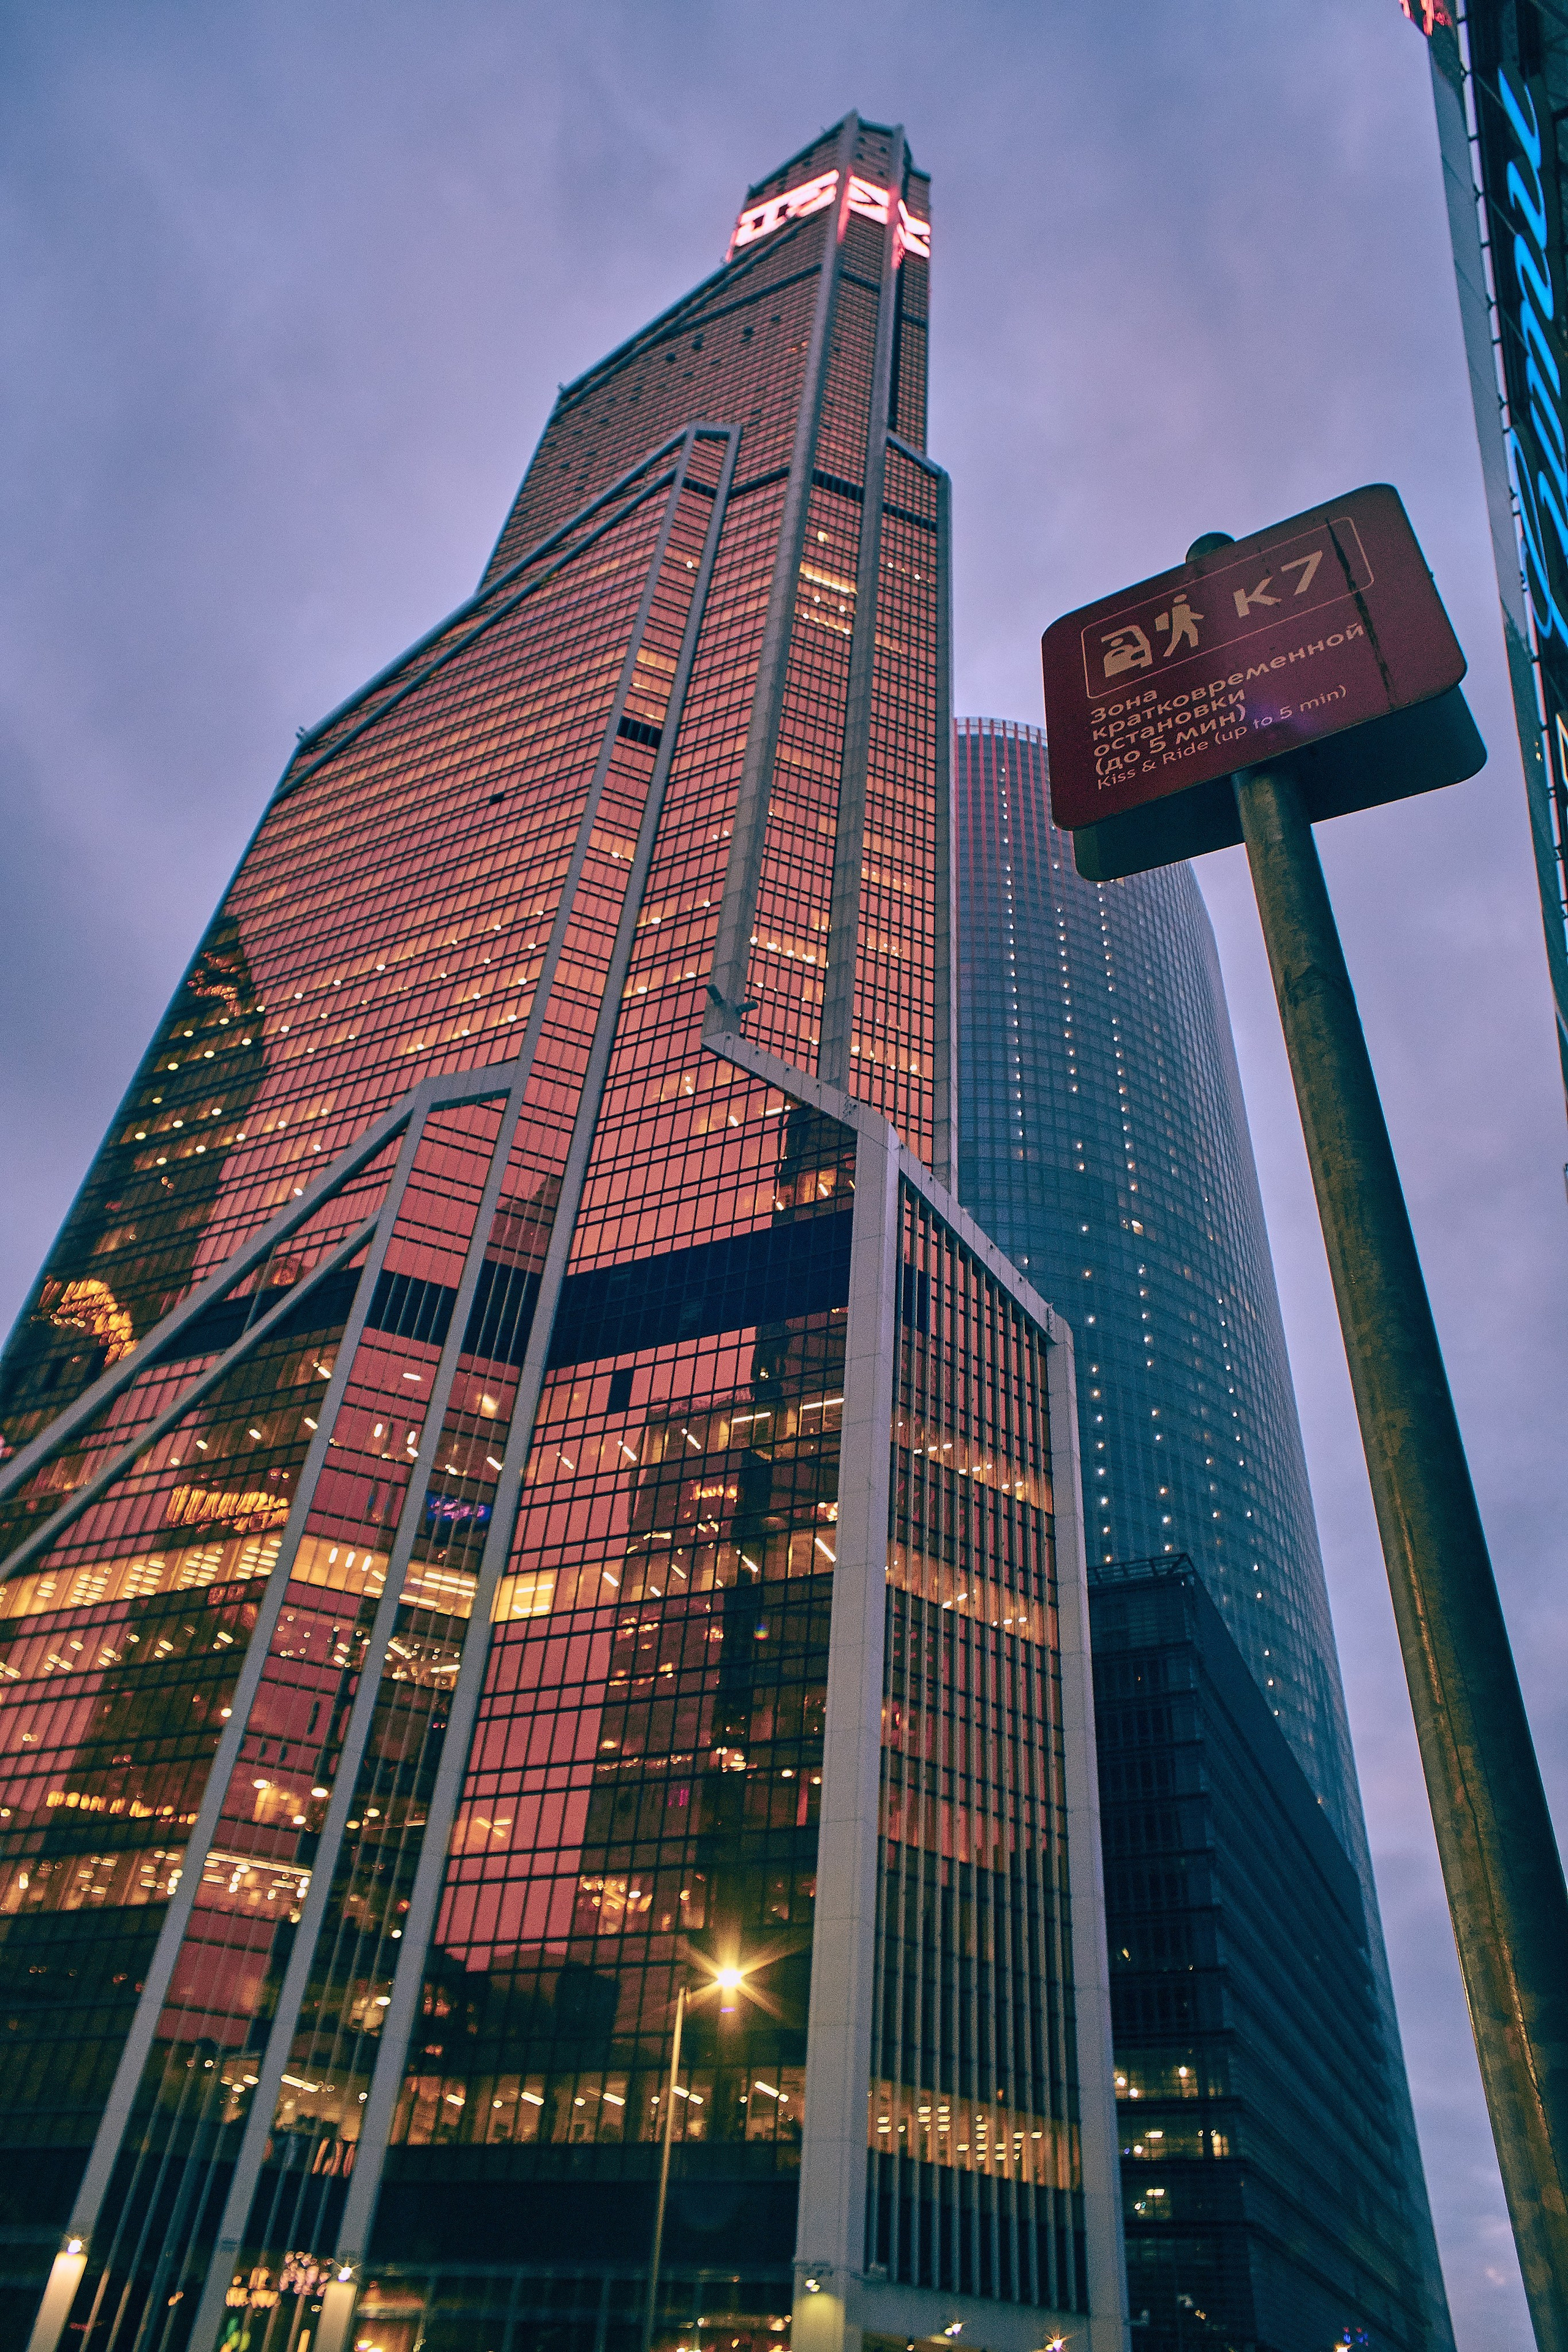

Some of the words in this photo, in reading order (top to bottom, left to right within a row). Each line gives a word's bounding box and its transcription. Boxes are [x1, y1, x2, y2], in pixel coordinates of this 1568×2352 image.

[1090, 690, 1157, 724] Зона
[1093, 622, 1364, 741] кратковременной
[1094, 689, 1245, 756] остановки
[1096, 750, 1140, 776] (до
[1150, 735, 1166, 753] 5
[1175, 704, 1246, 744] мин)
[1098, 769, 1136, 790] Kiss
[1142, 760, 1156, 772] &
[1163, 741, 1208, 764] Ride
[1215, 726, 1247, 745] (up
[1253, 717, 1272, 729] to
[1280, 706, 1292, 719] 5
[1300, 684, 1346, 712] min)
